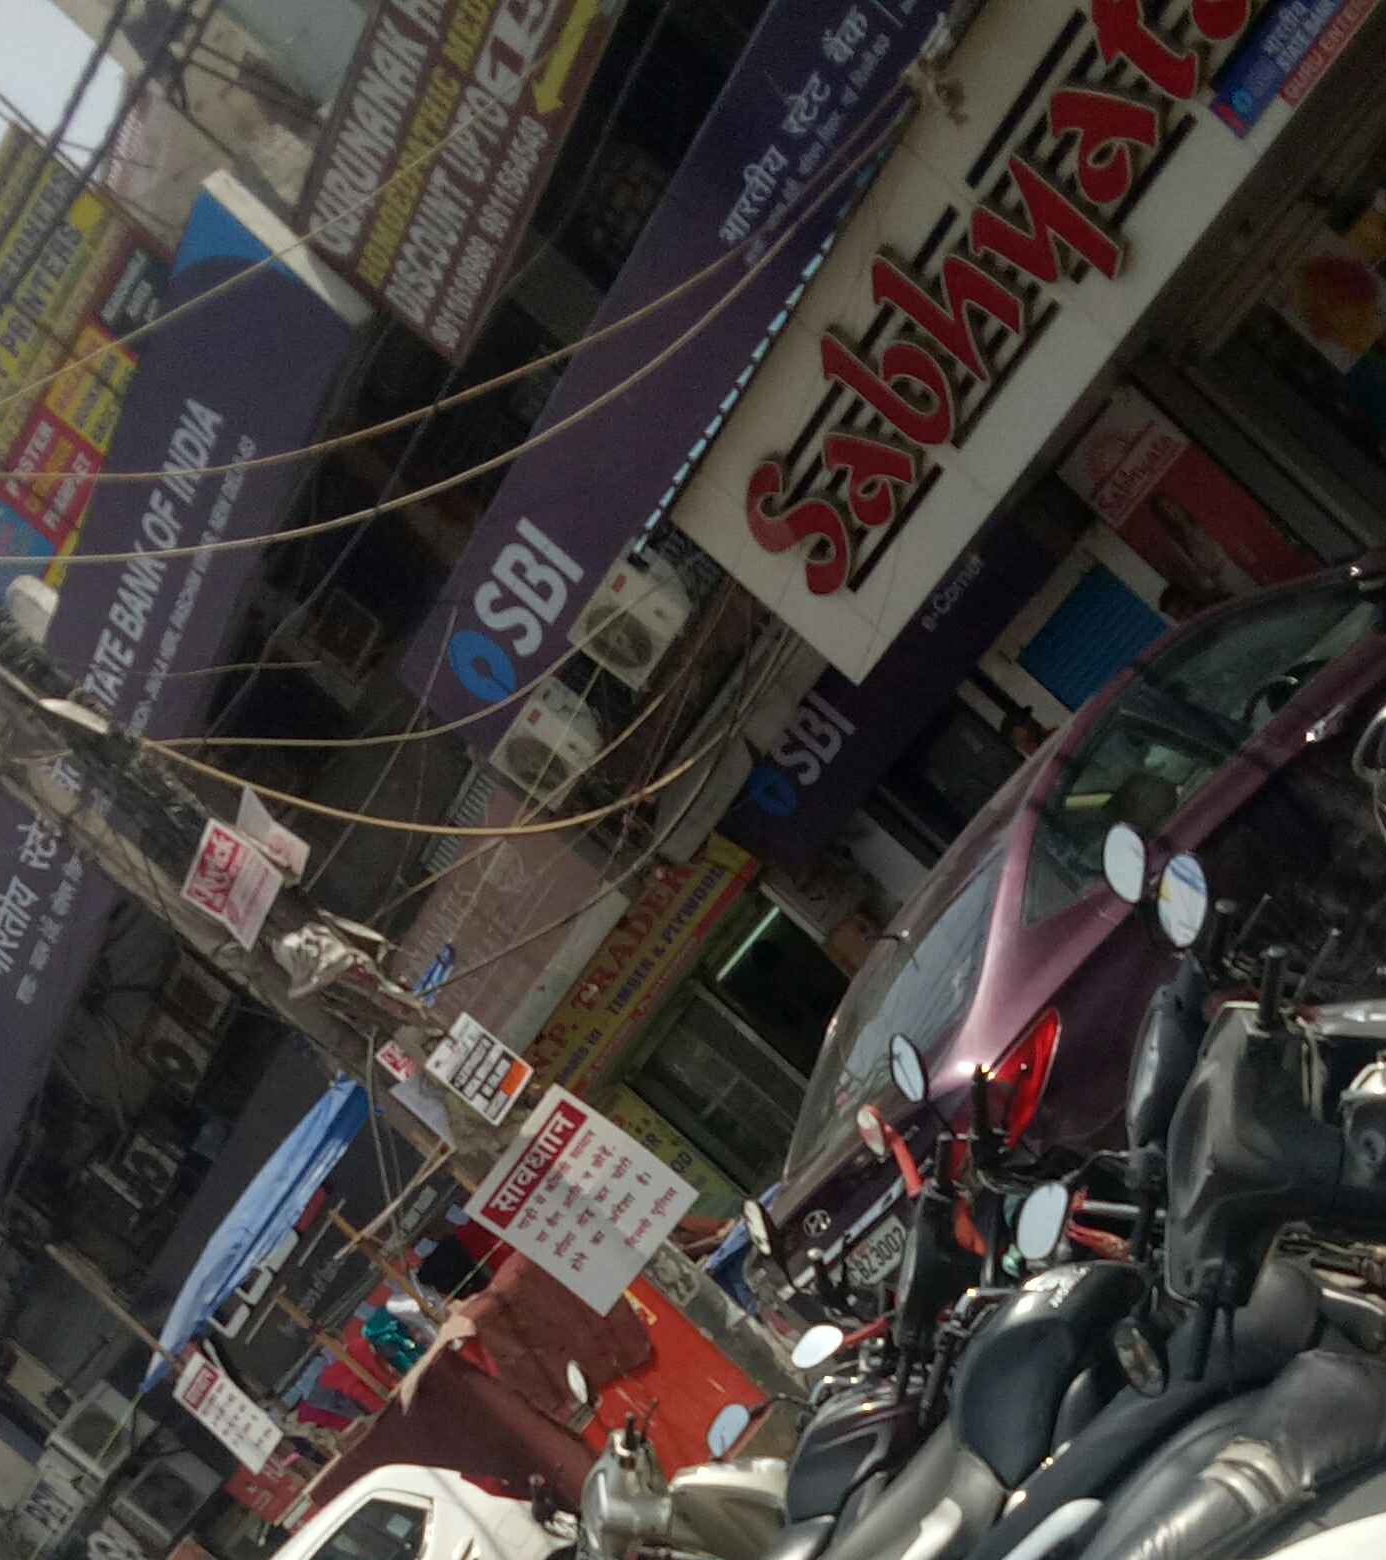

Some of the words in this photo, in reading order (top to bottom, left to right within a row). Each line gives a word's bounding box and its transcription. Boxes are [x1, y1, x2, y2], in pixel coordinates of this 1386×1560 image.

[310, 16, 428, 256] GURUNANAK
[385, 167, 473, 323] DISCOUNT
[710, 138, 793, 249] भारतीय
[1, 224, 85, 358] PRINTERS
[154, 396, 226, 501] INDIA
[136, 485, 189, 550] OF
[101, 542, 170, 642] BANK
[476, 518, 586, 659] SBI
[79, 627, 138, 708] TATE
[772, 688, 859, 787] SBI
[606, 952, 657, 1017] TIMBER
[657, 857, 728, 949] PLYWOOD
